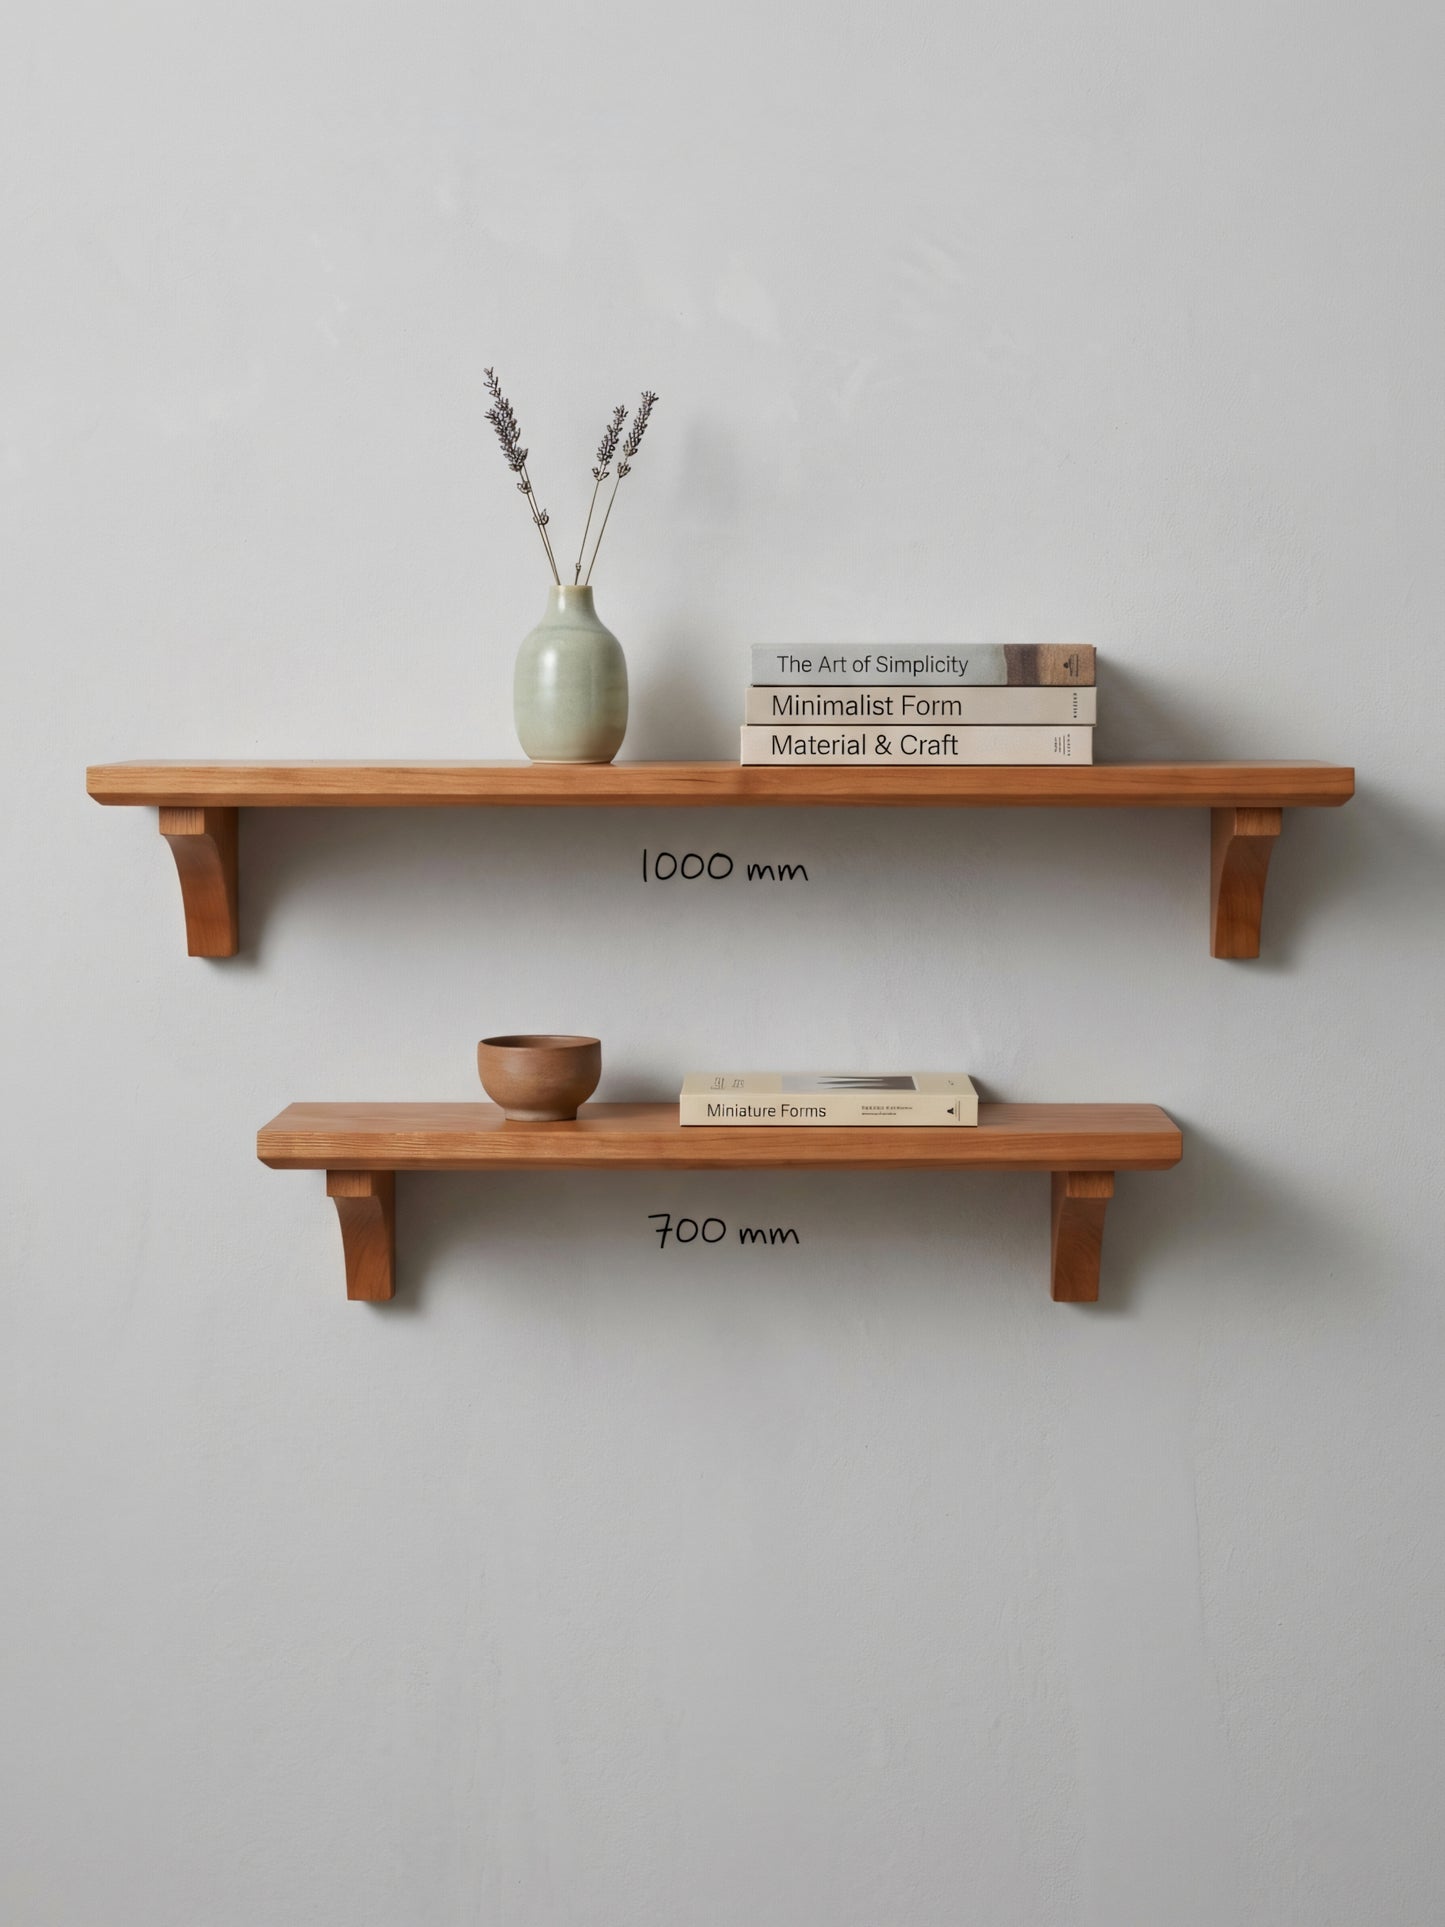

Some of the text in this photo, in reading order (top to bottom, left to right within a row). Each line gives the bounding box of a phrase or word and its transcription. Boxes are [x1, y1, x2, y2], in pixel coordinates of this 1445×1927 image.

[777, 655, 969, 677] The Art of Simplicity
[772, 694, 962, 716] Minimalist Form
[771, 733, 959, 756] Material & Craft
[642, 848, 809, 883] 1000 mm
[707, 1103, 827, 1118] Miniature Forms
[647, 1213, 800, 1249] 700 mm
